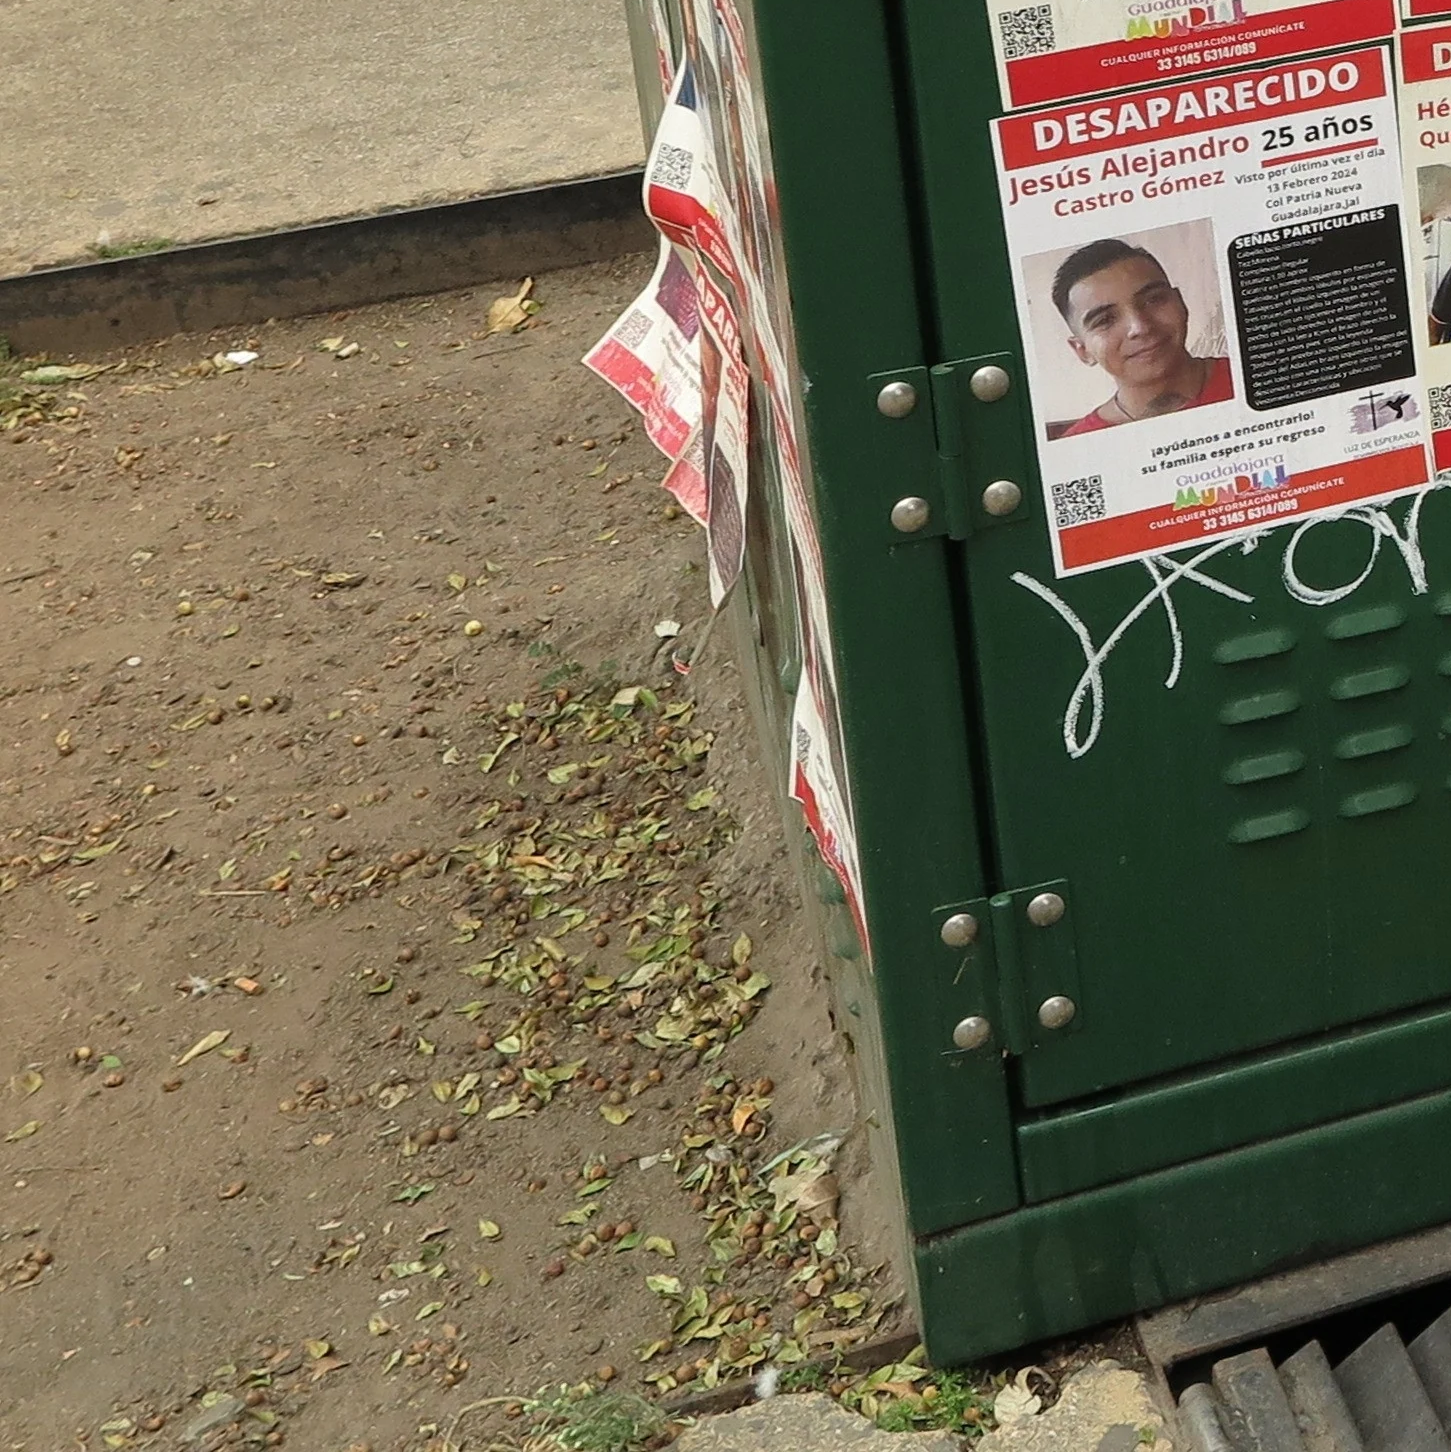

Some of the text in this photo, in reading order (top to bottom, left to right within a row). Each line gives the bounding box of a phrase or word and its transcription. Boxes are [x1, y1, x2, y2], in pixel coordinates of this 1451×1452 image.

[1031, 60, 1360, 152] DESAPARECIDO
[1260, 113, 1373, 152] 25 años
[1009, 133, 1250, 205] Jesús Alejandro
